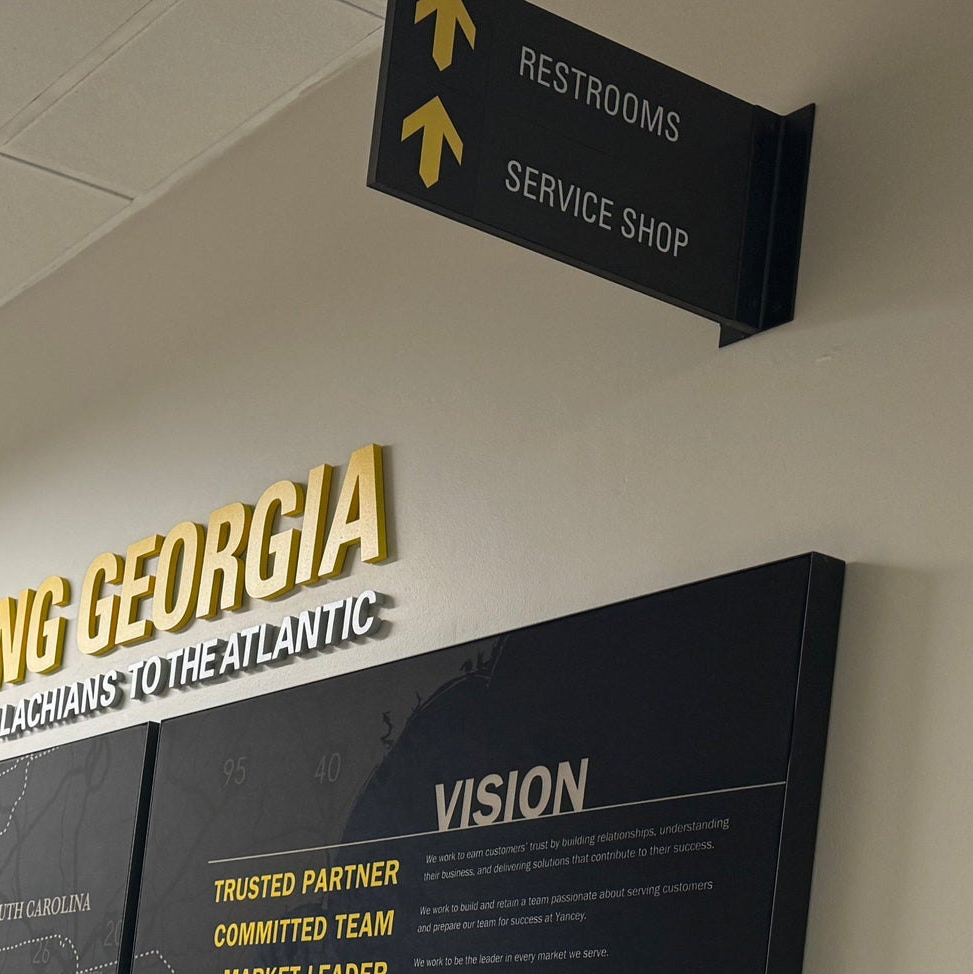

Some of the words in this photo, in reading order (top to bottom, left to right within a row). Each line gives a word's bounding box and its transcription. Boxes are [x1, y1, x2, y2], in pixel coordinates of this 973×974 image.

[520, 46, 681, 143] RESTROOMS
[505, 159, 613, 231] SERVICE
[620, 207, 689, 258] SHOP
[77, 443, 388, 656] GEORGIA
[128, 655, 163, 699] TO
[167, 638, 219, 688] THE
[219, 590, 378, 674] ATLANTIC
[315, 752, 341, 785] 40
[435, 757, 589, 832] VISION
[425, 854, 437, 863] We
[438, 850, 457, 864] work
[456, 848, 466, 863] to
[465, 847, 485, 862] earn
[484, 841, 528, 858] customers'
[528, 839, 549, 852] trust
[549, 838, 560, 850] by
[561, 833, 596, 848] building
[596, 827, 656, 842] relationships,
[659, 817, 730, 835] understanding
[214, 872, 296, 903] TRUSTED
[302, 859, 400, 894] PARTNER
[26, 892, 92, 919] CAROLINA
[416, 922, 431, 935] and
[432, 920, 461, 934] prepare
[460, 920, 476, 931] our
[476, 919, 496, 928] team
[497, 917, 509, 926] for
[510, 914, 543, 928] success
[543, 913, 552, 923] at
[555, 911, 586, 922] Yancey.
[214, 916, 327, 948] COMMITTED
[335, 909, 395, 939] TEAM
[413, 957, 424, 967] We
[425, 956, 443, 966] work
[444, 956, 452, 967] to
[453, 955, 463, 966] be
[464, 954, 477, 965] the
[478, 953, 503, 964] leader
[504, 953, 512, 962] in
[513, 951, 536, 963] every
[537, 950, 566, 960] market
[568, 950, 581, 958] we
[582, 948, 608, 958] serve.
